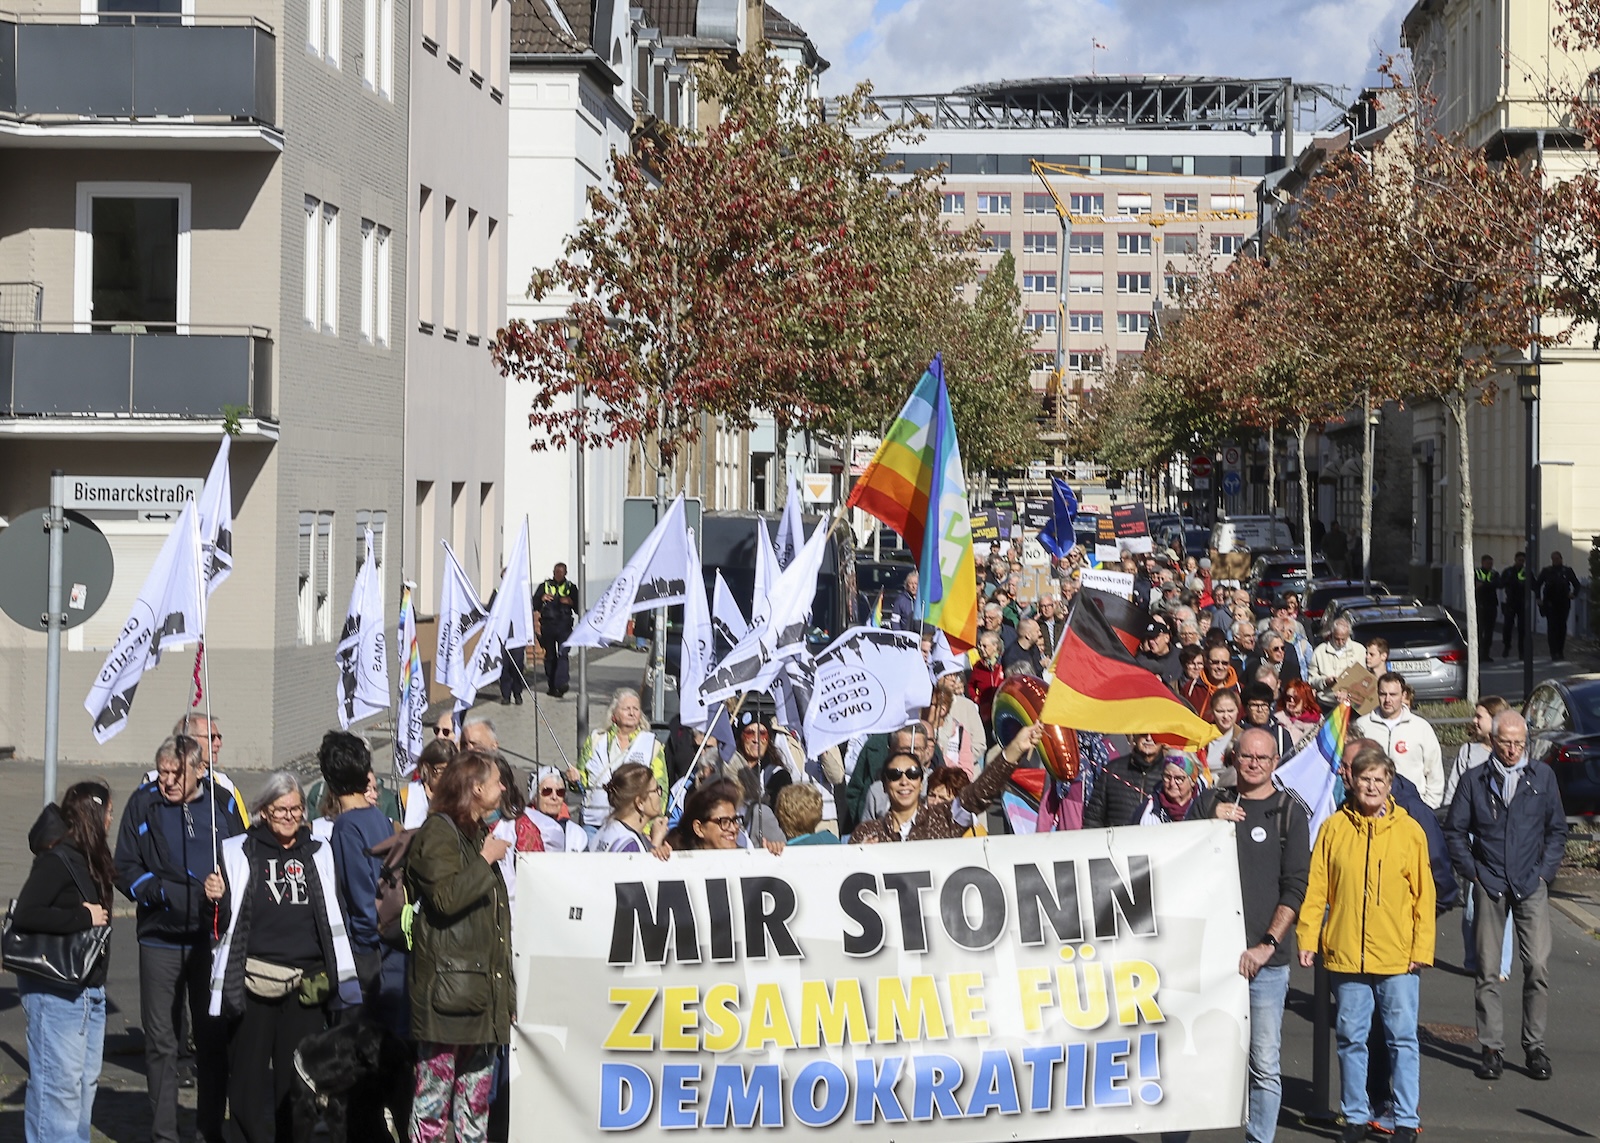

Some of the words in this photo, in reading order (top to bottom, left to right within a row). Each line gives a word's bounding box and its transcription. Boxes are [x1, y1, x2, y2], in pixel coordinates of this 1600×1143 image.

[1082, 572, 1132, 586] Demokratie
[820, 671, 867, 695] RECHT
[818, 686, 870, 713] GEGEN
[828, 701, 872, 724] OMAS
[608, 876, 805, 966] MIR
[840, 855, 1159, 959] STONN
[602, 971, 992, 1052] ZESAMME
[1018, 943, 1166, 1034] FÜR
[598, 1032, 1164, 1132] DEMOKRATIE!
